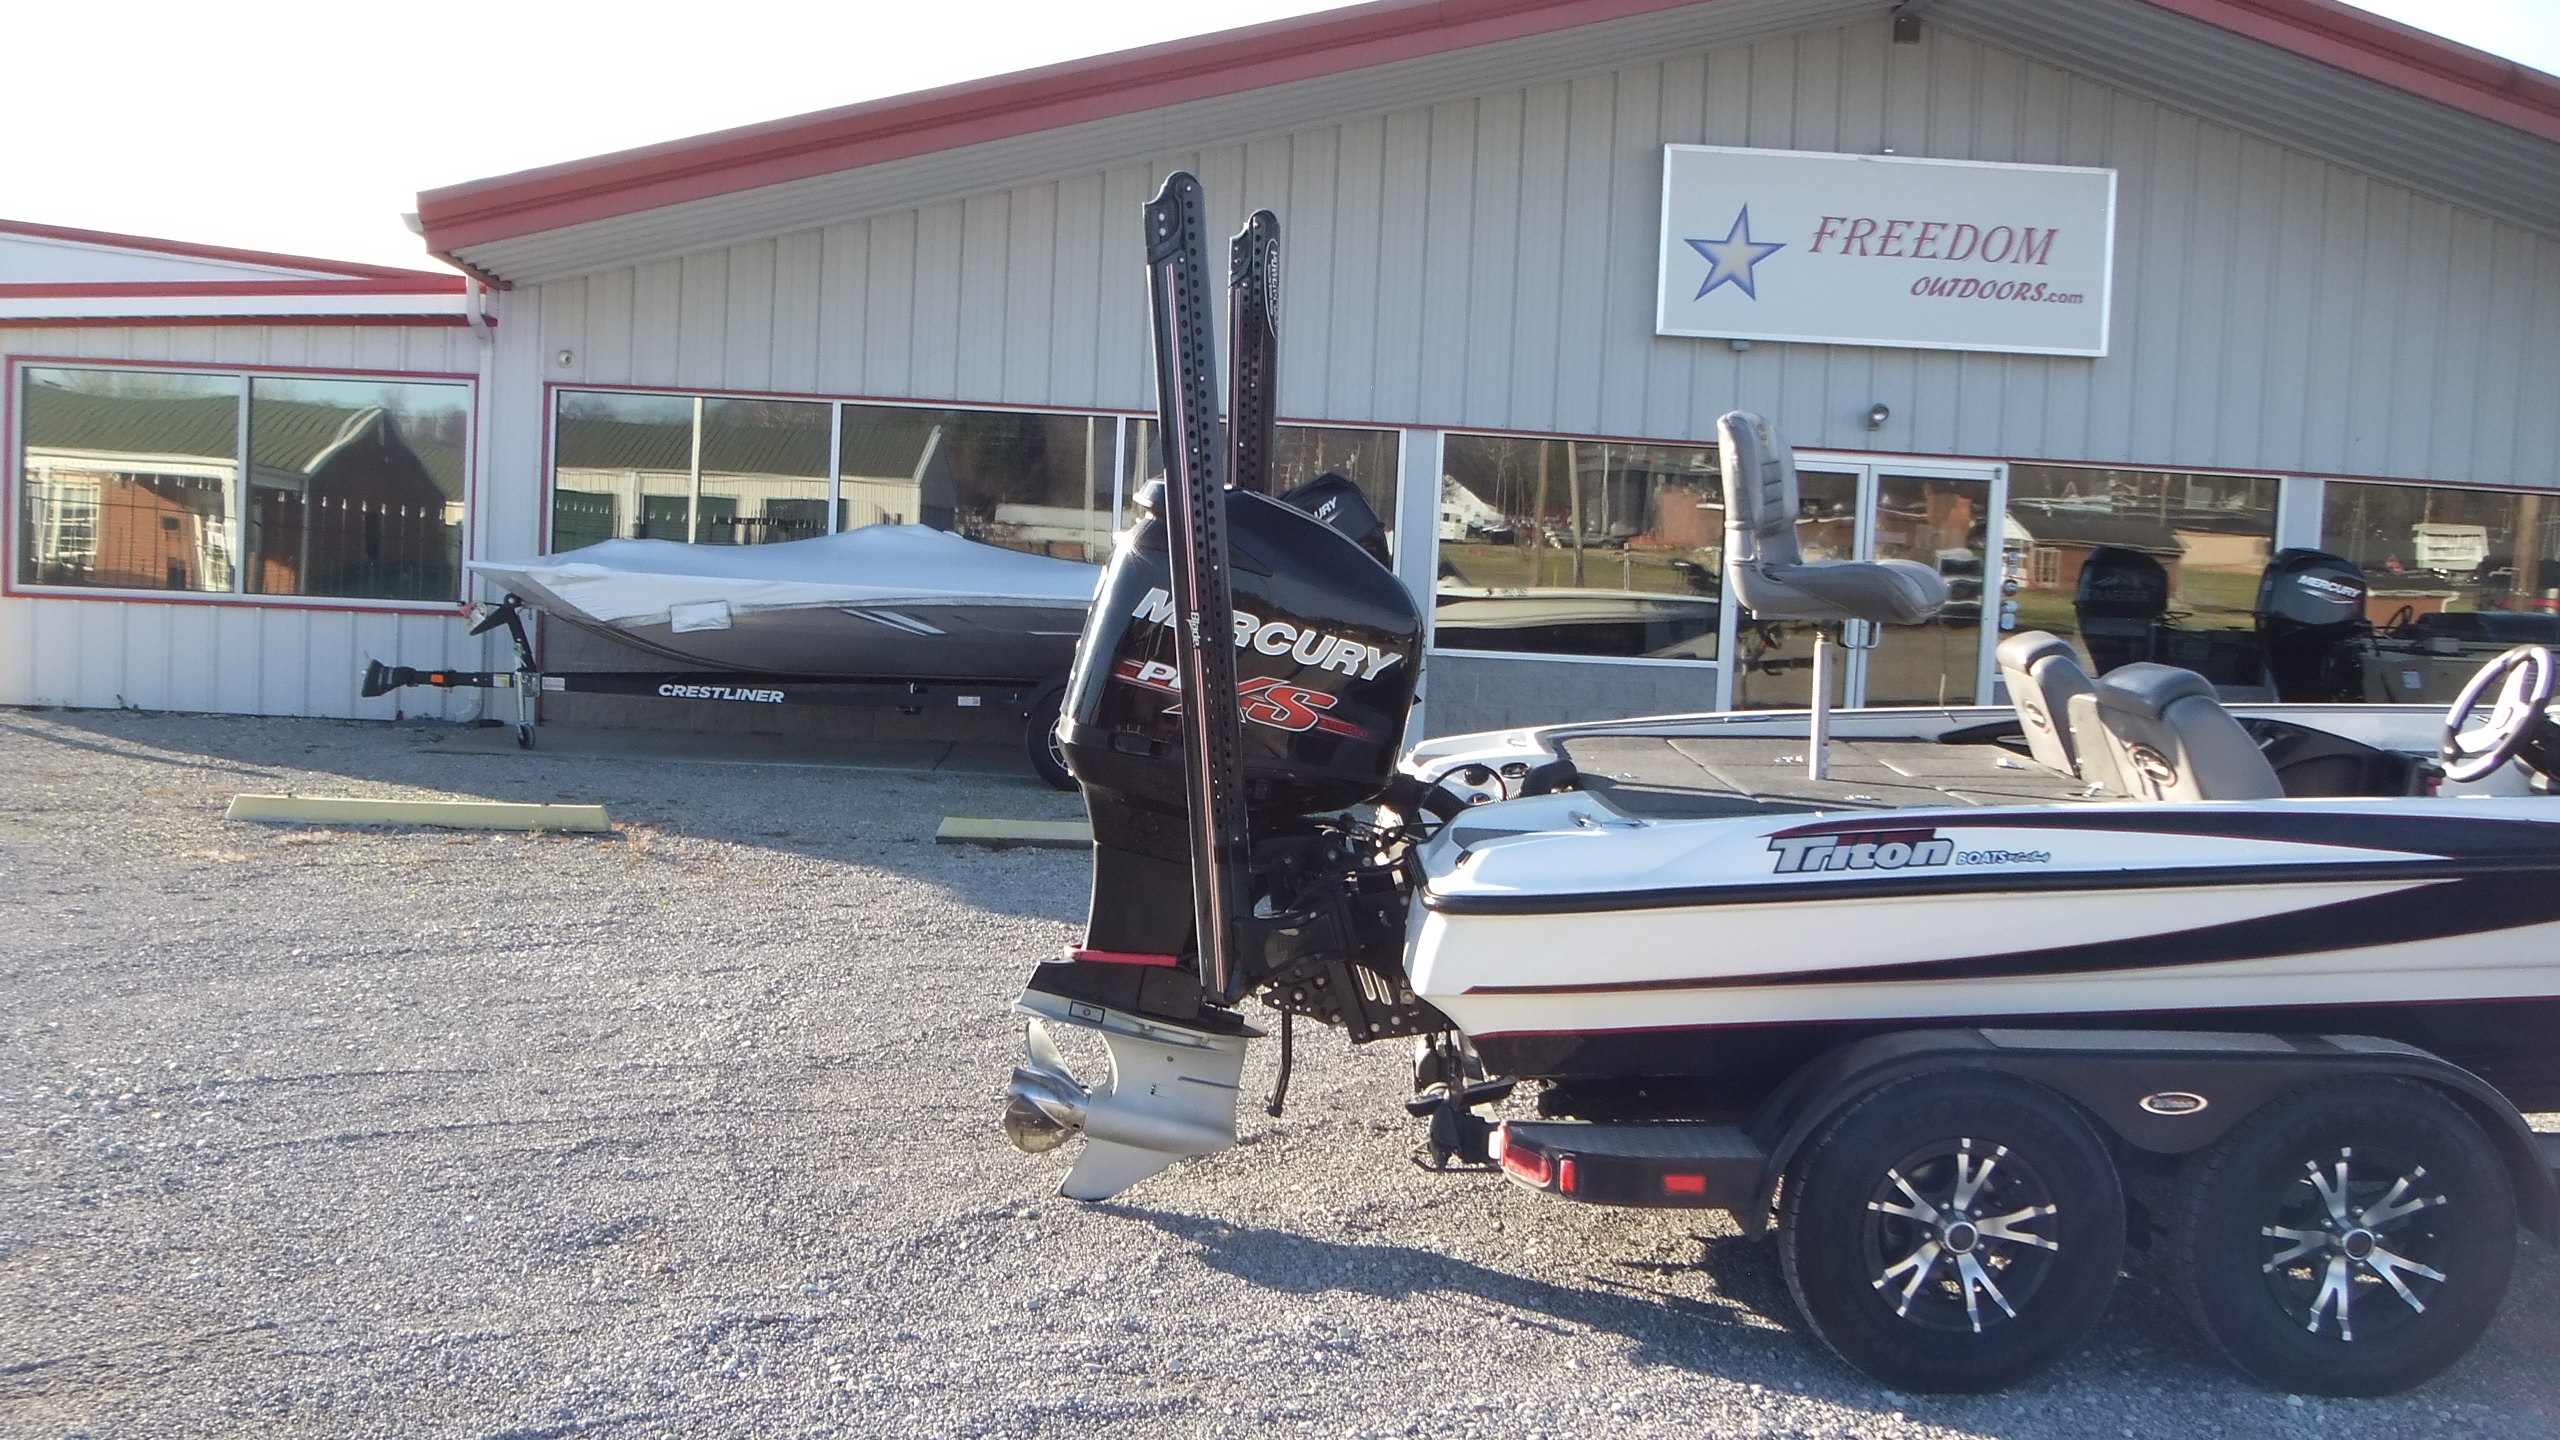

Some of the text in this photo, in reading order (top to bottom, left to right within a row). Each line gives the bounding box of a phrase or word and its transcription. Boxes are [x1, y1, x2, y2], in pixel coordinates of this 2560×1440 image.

[1808, 216, 2059, 266] FREEDOM
[1910, 276, 2084, 304] OUTDOORS.com
[2296, 575, 2362, 598] MERCURY
[1132, 587, 1402, 681] MRCURY
[658, 684, 784, 703] CRESTLINER
[1767, 830, 1954, 873] Triton
[1956, 851, 2008, 865] BOATS
